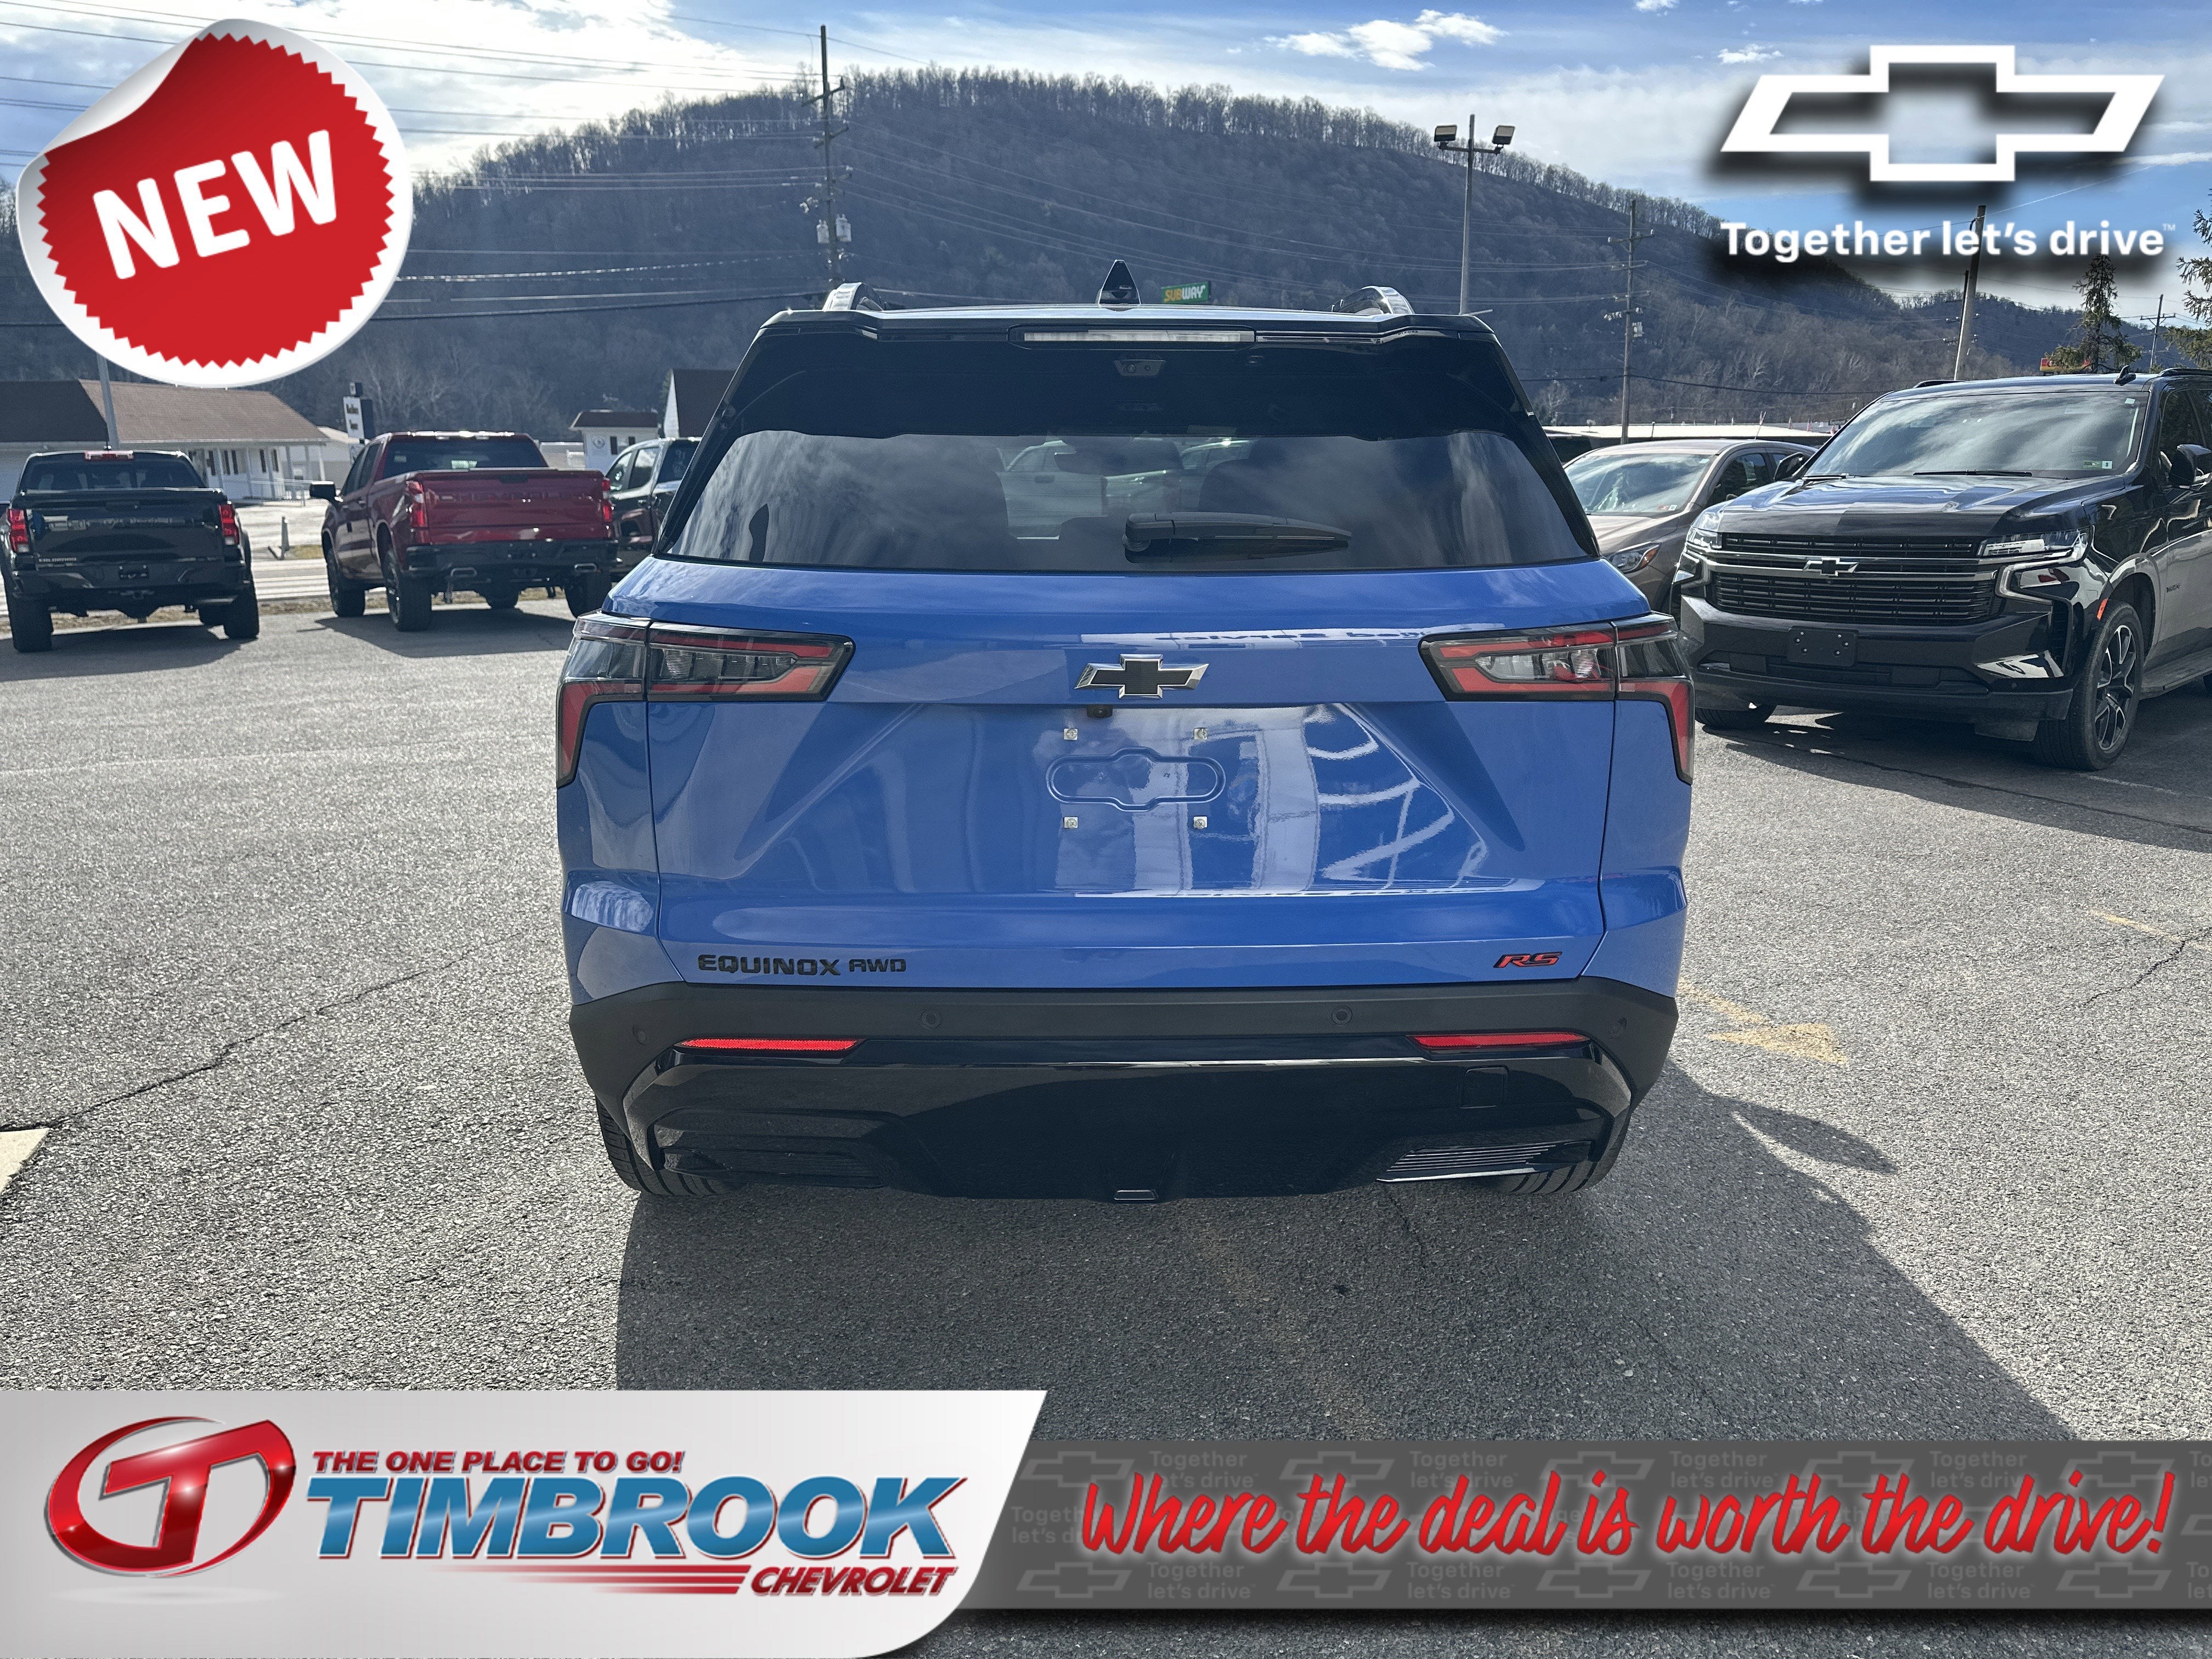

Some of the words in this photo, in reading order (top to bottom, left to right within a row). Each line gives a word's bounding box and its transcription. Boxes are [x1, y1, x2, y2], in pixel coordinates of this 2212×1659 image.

[1164, 284, 1206, 303] SUBWAY
[697, 953, 842, 976] EQUINOX
[848, 958, 907, 973] AWD
[1493, 951, 1563, 968] RS
